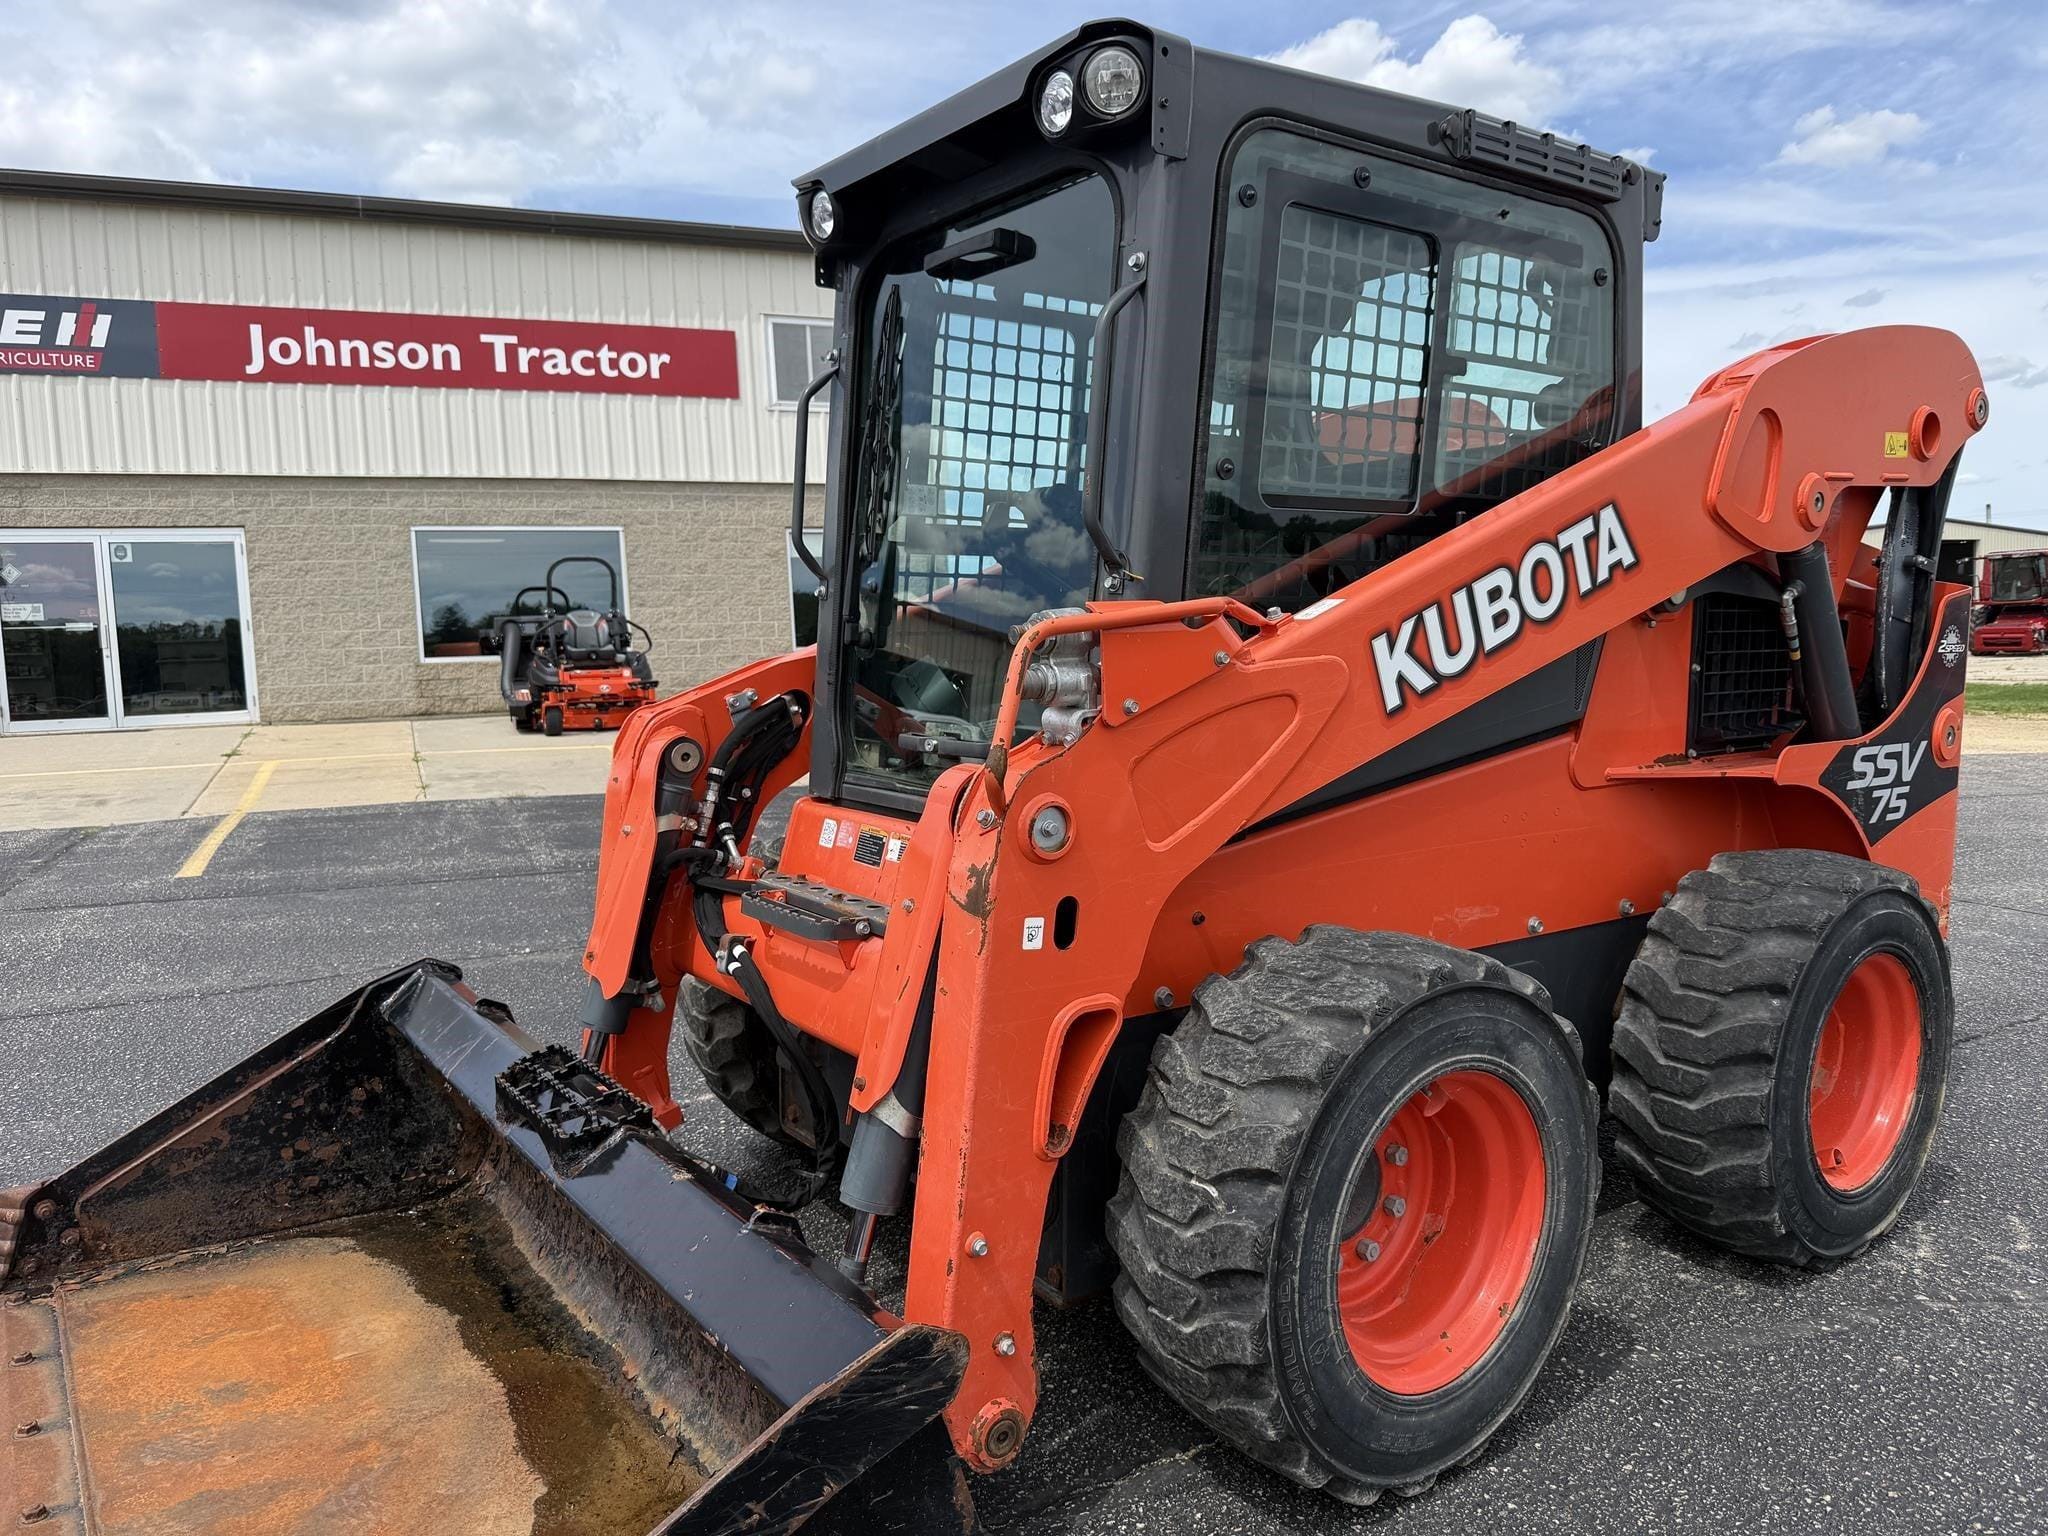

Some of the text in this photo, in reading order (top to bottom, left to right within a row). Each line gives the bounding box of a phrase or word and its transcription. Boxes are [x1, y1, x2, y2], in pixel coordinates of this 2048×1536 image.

[244, 323, 671, 380] Johnson Tractor
[1370, 503, 1640, 714] KUBOTA
[1846, 740, 1928, 790] SSV
[1868, 785, 1911, 824] 75
